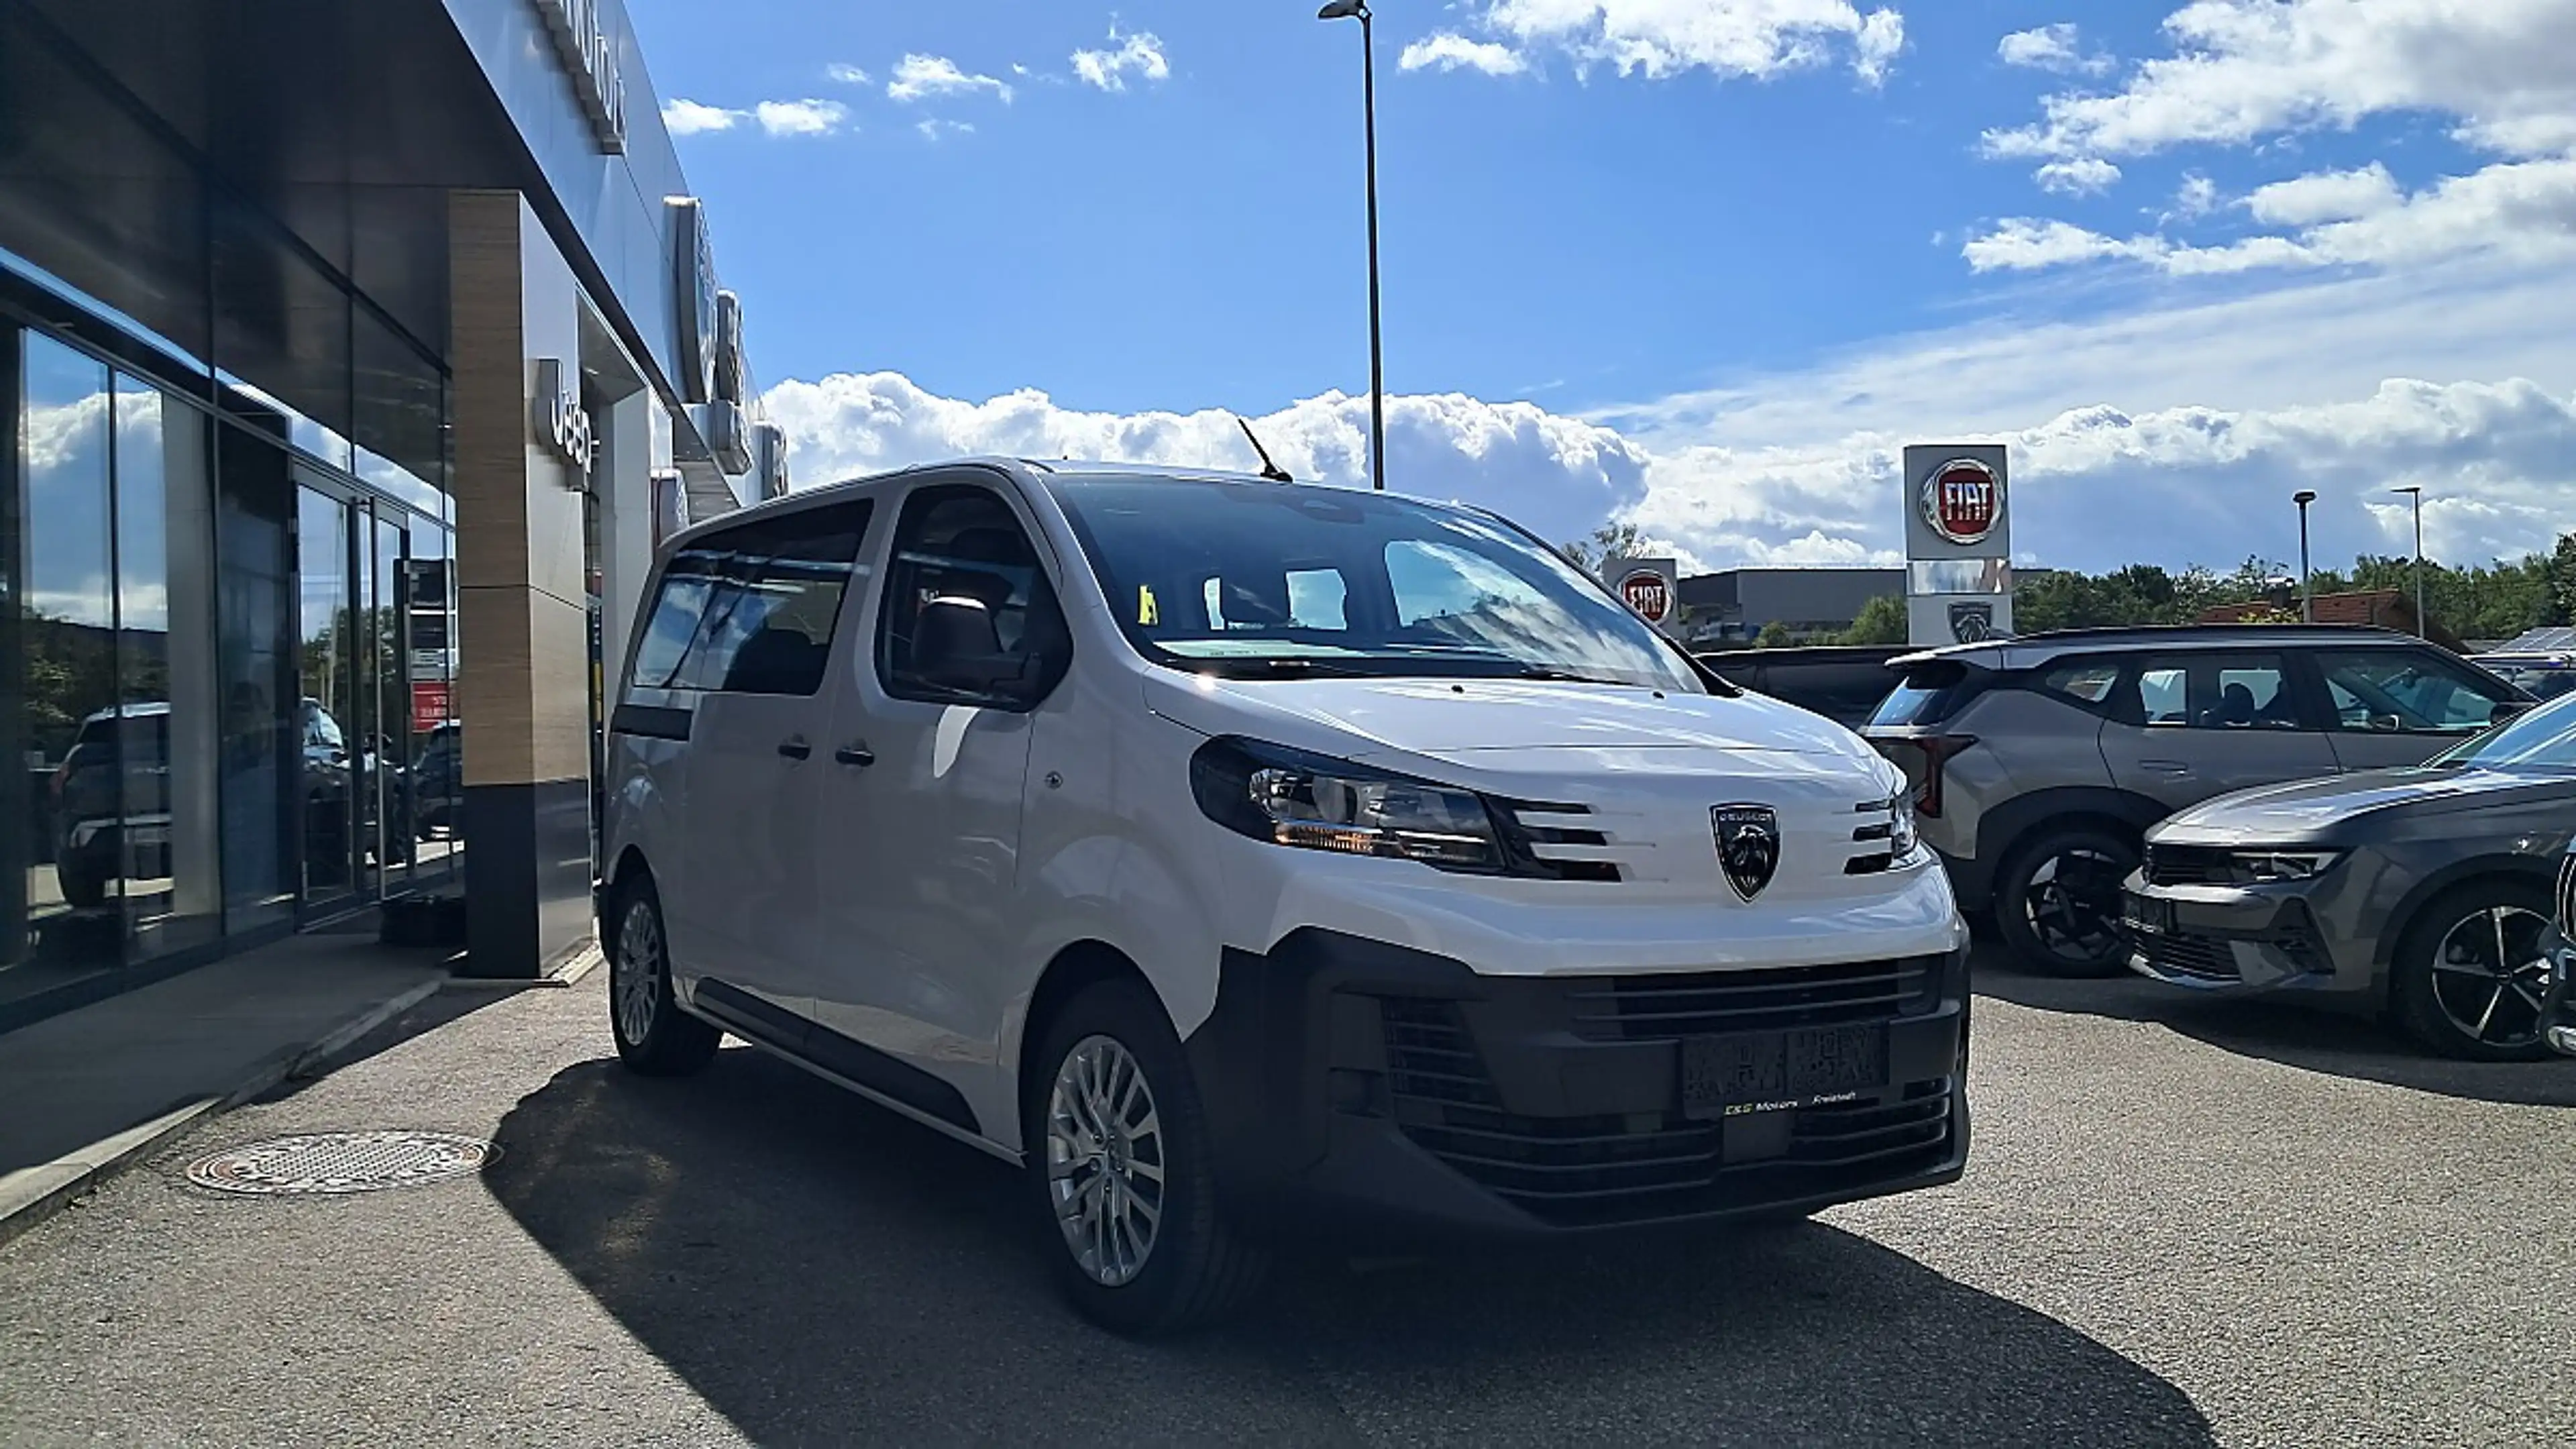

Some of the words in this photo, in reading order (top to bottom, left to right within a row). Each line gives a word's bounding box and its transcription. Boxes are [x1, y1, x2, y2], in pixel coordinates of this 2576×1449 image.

[551, 362, 592, 492] Jeep
[1945, 482, 1990, 521] FIAT
[1629, 585, 1662, 614] FIAT
